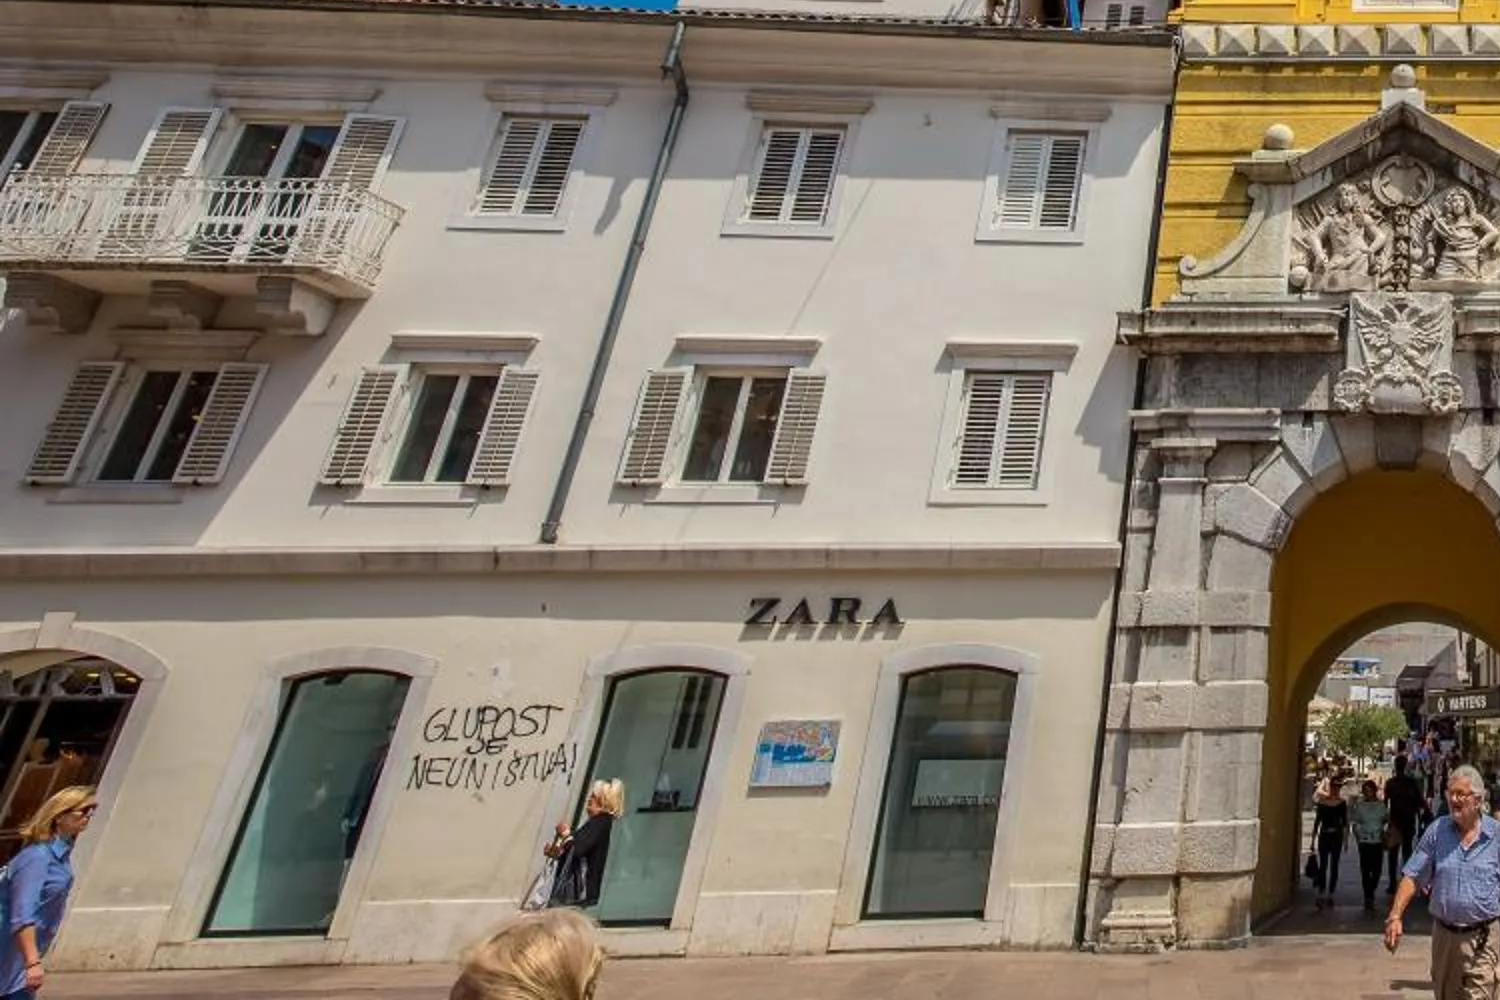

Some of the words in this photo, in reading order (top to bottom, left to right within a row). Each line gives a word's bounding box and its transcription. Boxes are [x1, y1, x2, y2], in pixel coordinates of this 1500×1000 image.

[745, 597, 905, 625] ZARA
[423, 703, 565, 743] GLUPOST
[465, 737, 509, 756] JE
